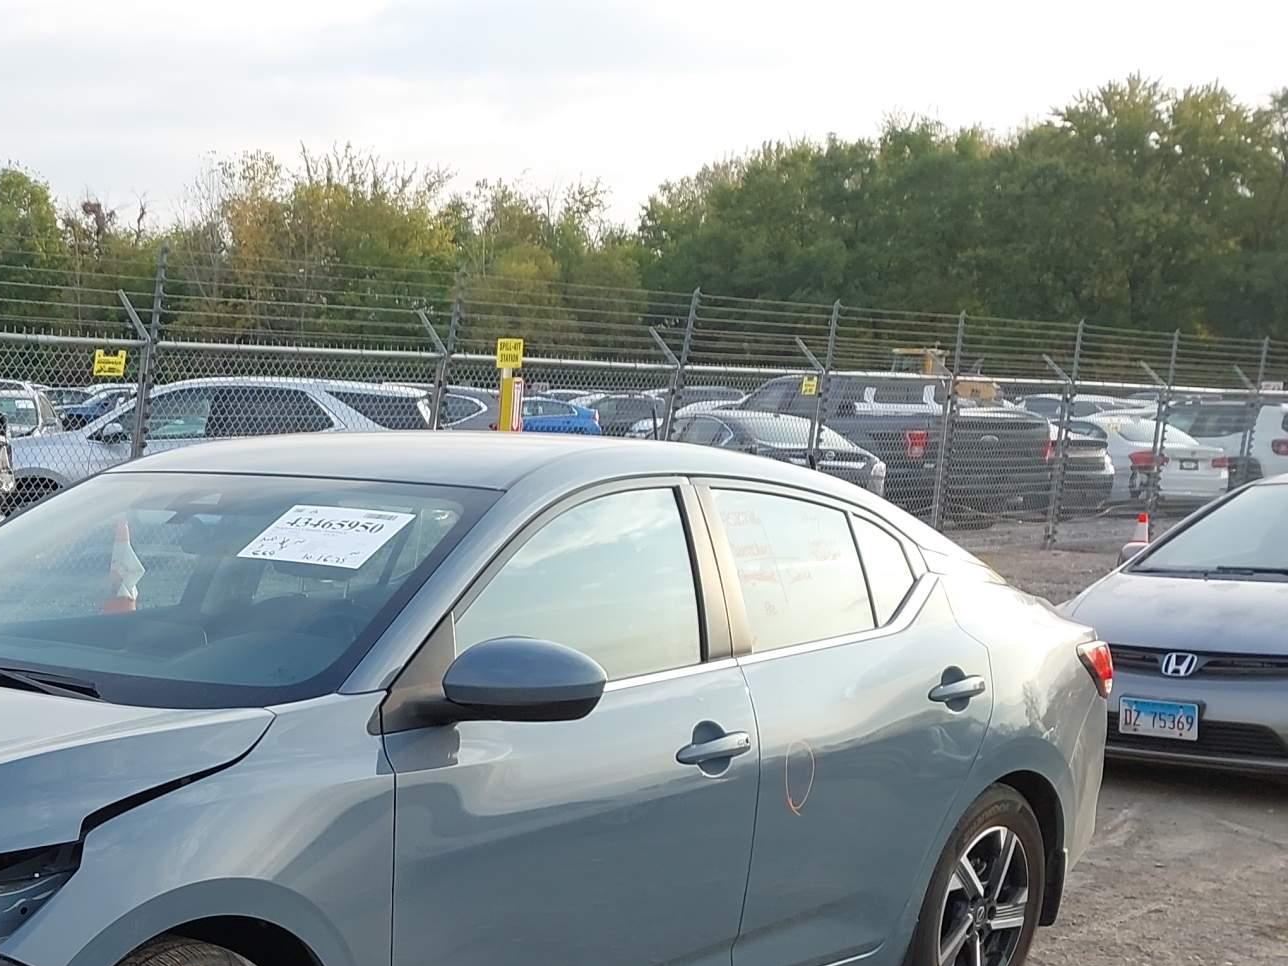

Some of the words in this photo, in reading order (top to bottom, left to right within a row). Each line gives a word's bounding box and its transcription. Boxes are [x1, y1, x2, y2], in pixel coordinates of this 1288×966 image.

[499, 341, 522, 352] SPILL-KIT
[499, 353, 519, 363] STATION
[286, 516, 385, 534] 43465950
[1124, 708, 1142, 727] DZ
[1150, 710, 1194, 732] 75369
